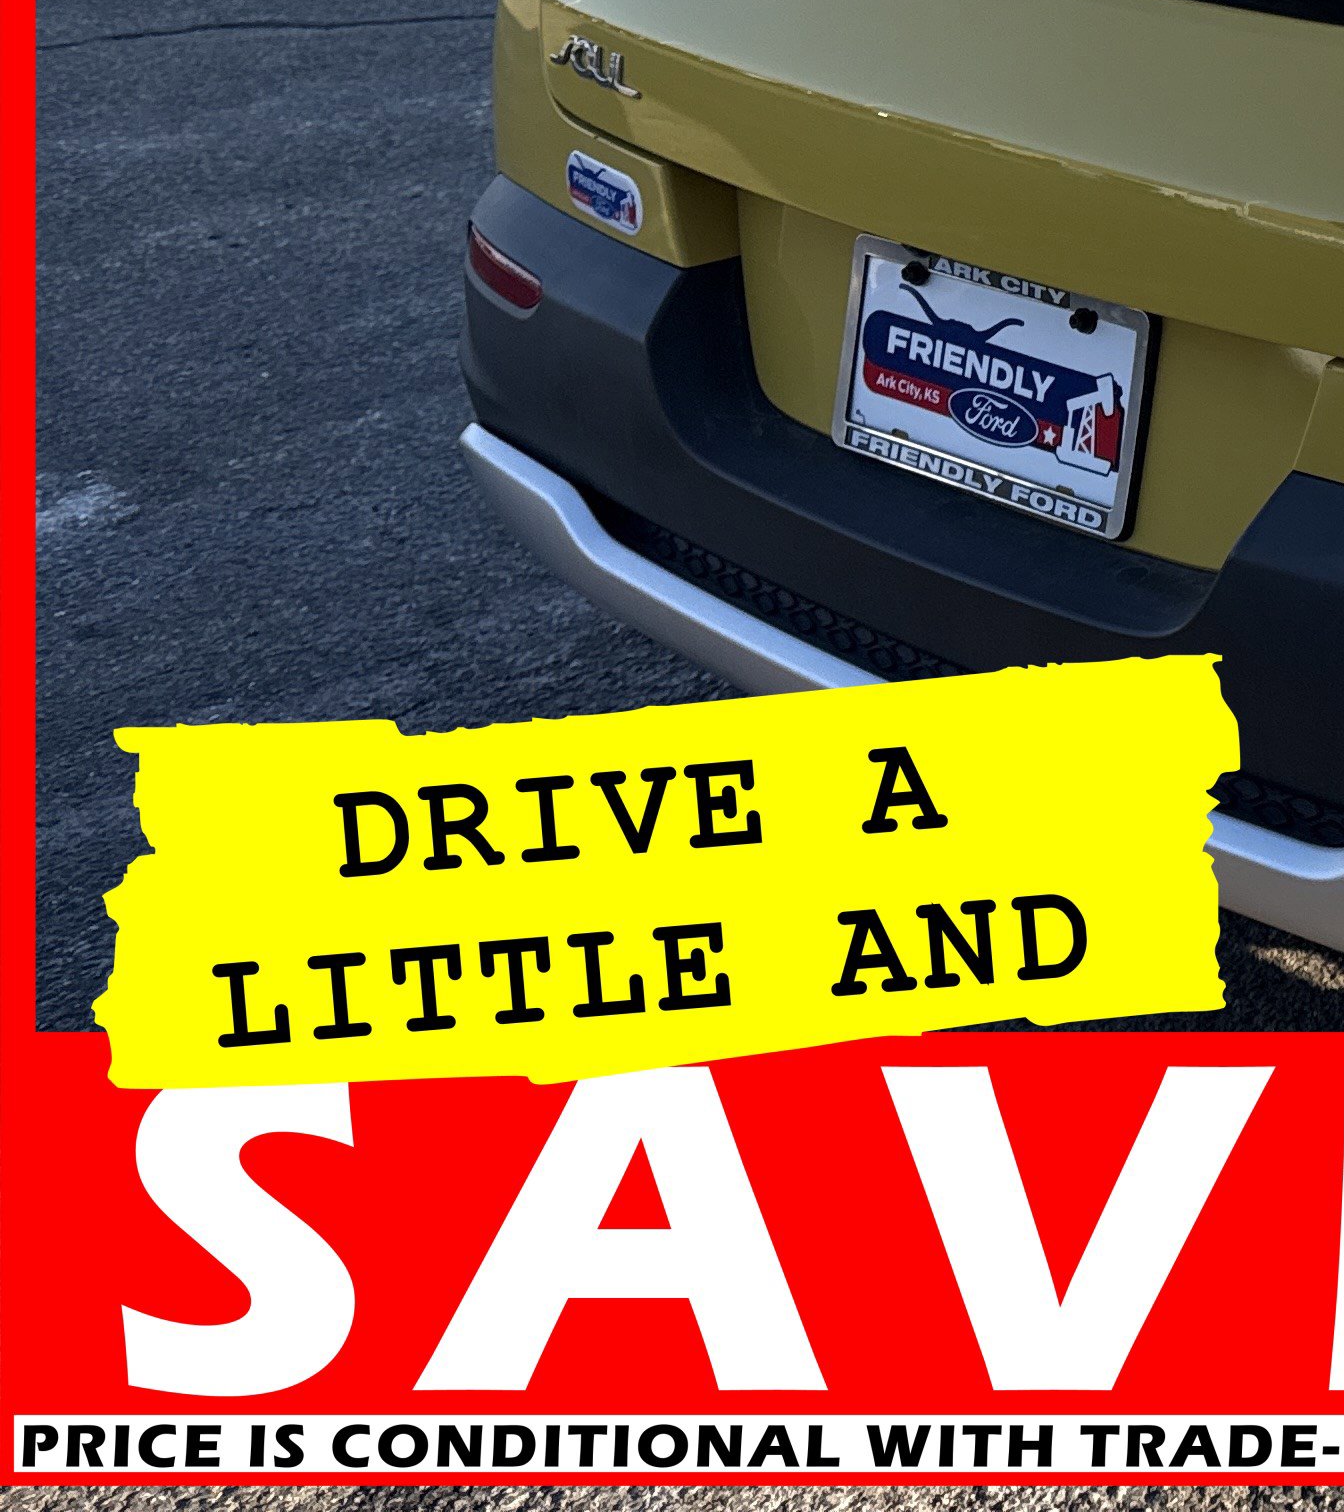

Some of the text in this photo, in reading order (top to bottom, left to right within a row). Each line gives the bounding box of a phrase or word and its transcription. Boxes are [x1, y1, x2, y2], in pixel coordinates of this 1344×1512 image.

[934, 257, 1067, 305] ARK CITY
[876, 373, 941, 405] Ark City, KS
[886, 326, 1055, 404] FRIENDLY
[964, 394, 1018, 439] Ford
[850, 430, 1103, 529] FRIENDLY FORD
